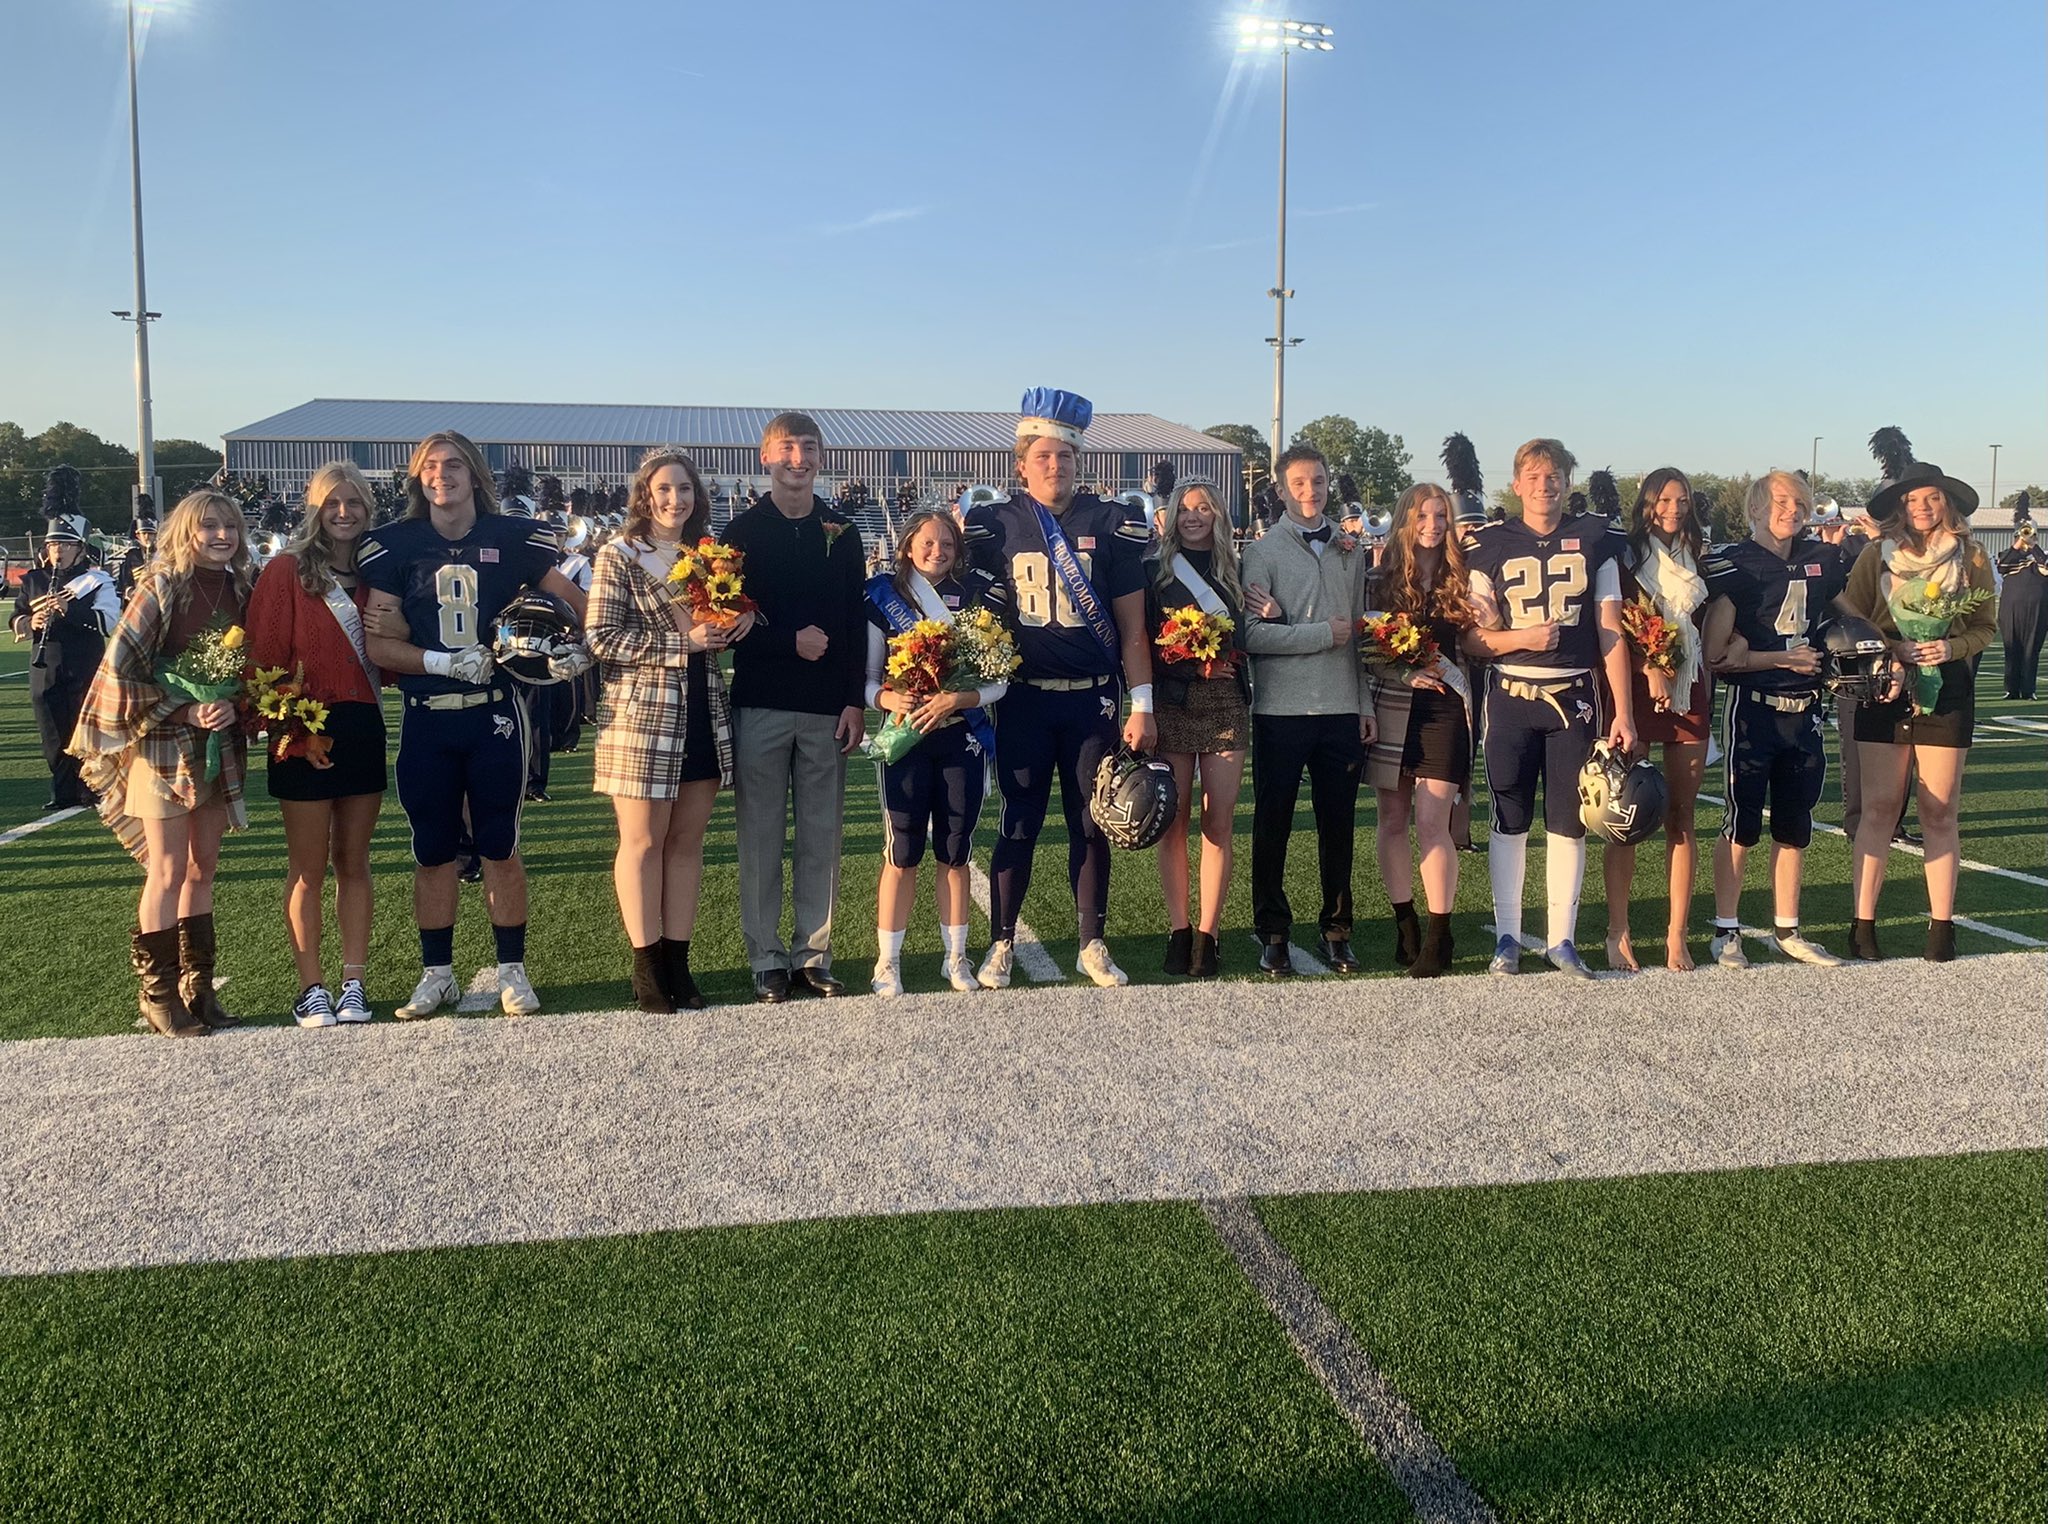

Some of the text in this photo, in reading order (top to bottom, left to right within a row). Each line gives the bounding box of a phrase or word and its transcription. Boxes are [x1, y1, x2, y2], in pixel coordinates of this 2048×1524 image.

[435, 564, 479, 649] 8
[885, 600, 915, 631] HOME
[1054, 541, 1115, 648] HOMECOMING KING
[1502, 553, 1588, 629] 22
[1774, 579, 1811, 650] 4
